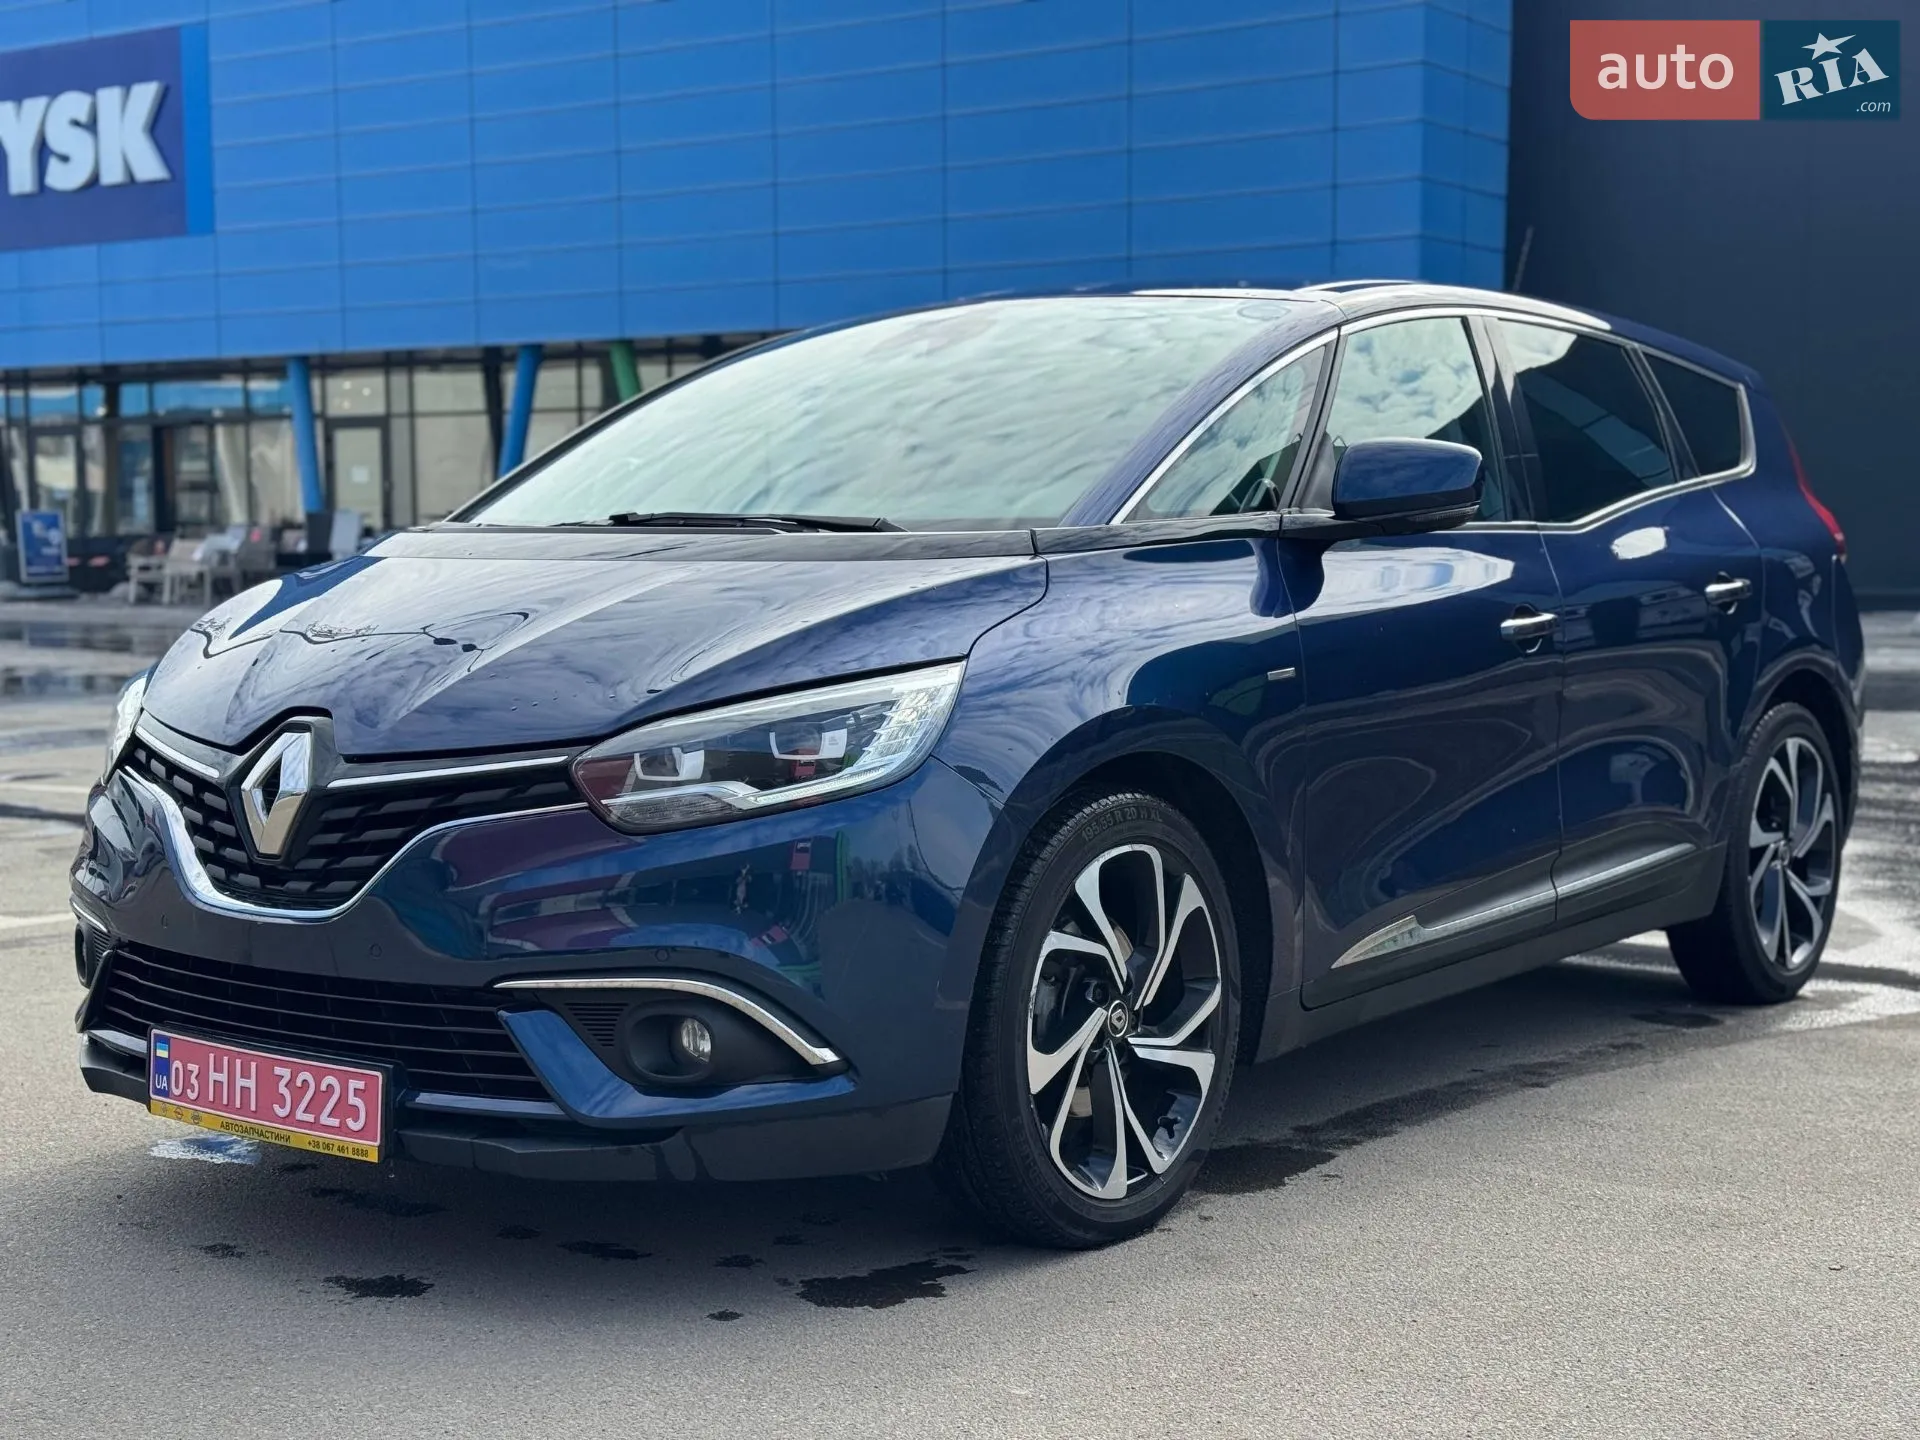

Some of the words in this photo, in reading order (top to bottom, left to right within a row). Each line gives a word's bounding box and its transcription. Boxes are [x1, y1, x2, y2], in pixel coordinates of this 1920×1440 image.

[0, 80, 172, 196] YSK
[155, 1074, 168, 1091] UA
[171, 1060, 200, 1101] 03
[208, 1053, 257, 1112] HH
[272, 1066, 367, 1132] 3225
[219, 1120, 291, 1144] АВТОЗАПЧАСТИНИ
[322, 1141, 335, 1152] 067
[336, 1144, 350, 1155] 461
